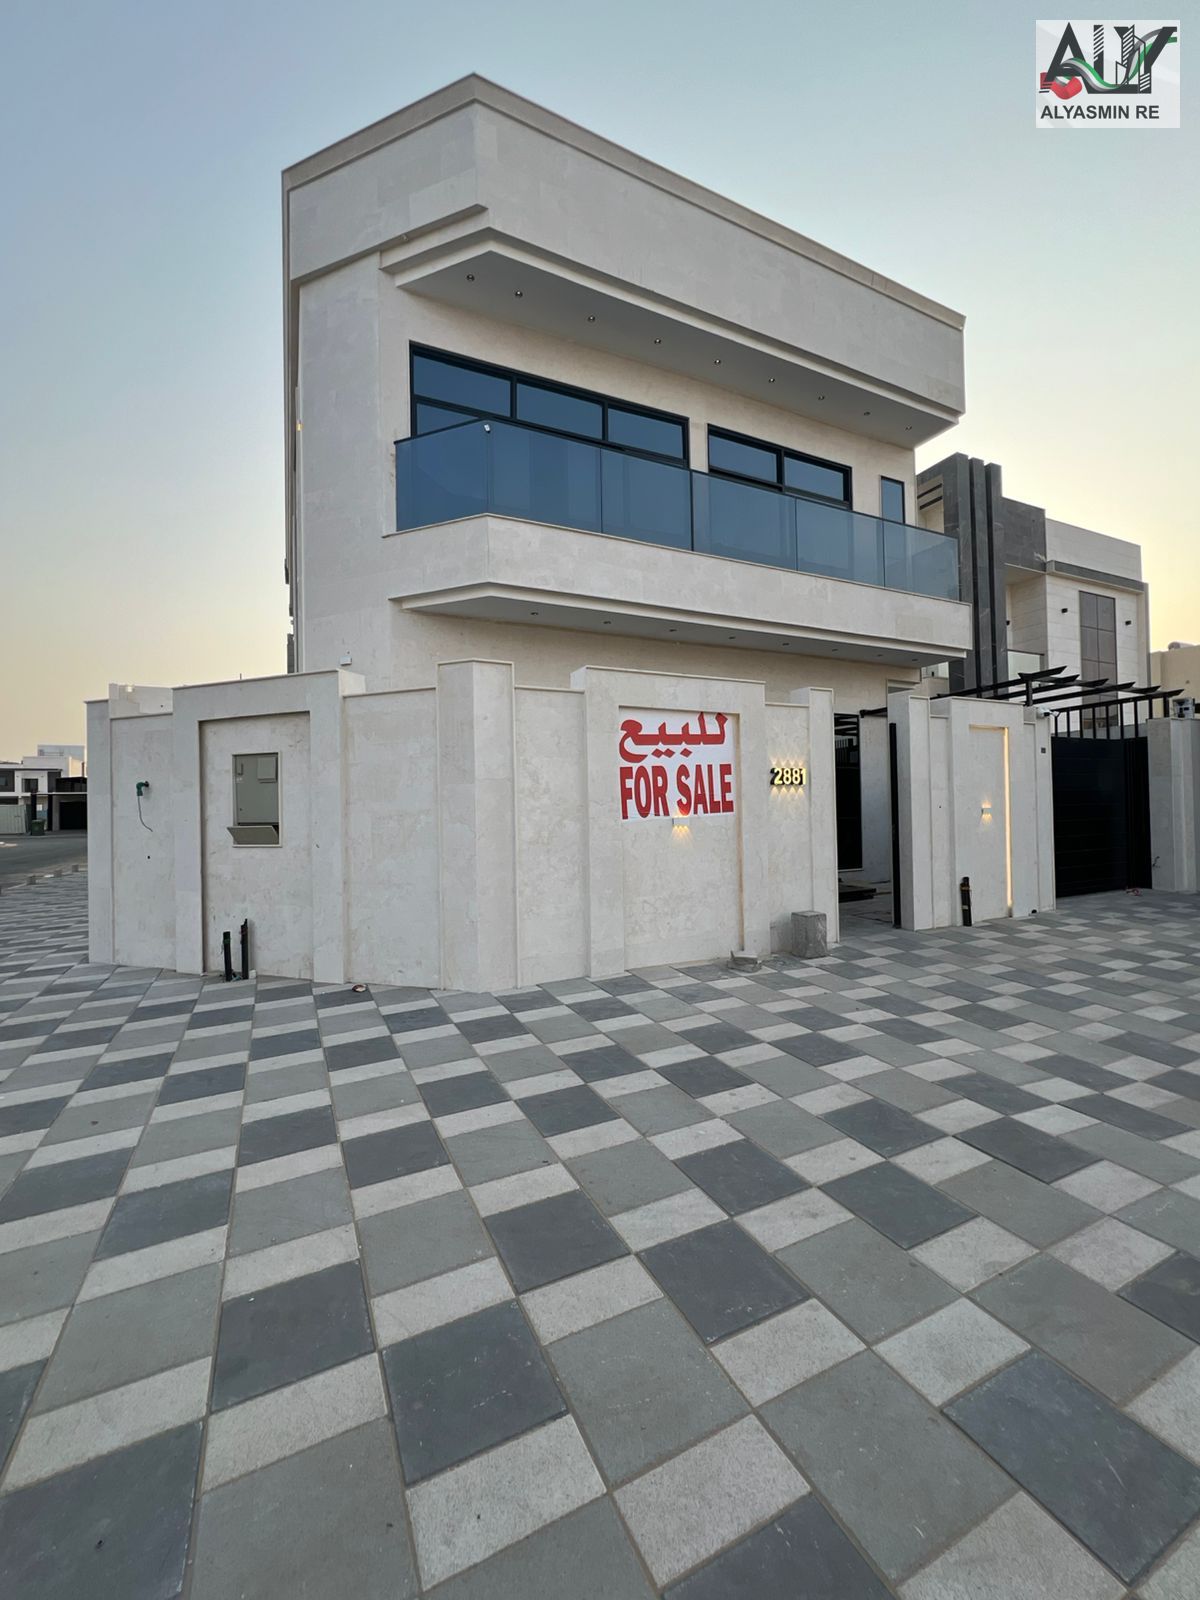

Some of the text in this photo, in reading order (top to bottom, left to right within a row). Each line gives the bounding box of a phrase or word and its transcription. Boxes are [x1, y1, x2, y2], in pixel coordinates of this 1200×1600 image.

[619, 711, 728, 763] للبيع
[619, 763, 734, 820] FOR SALE
[770, 767, 806, 785] 2881
